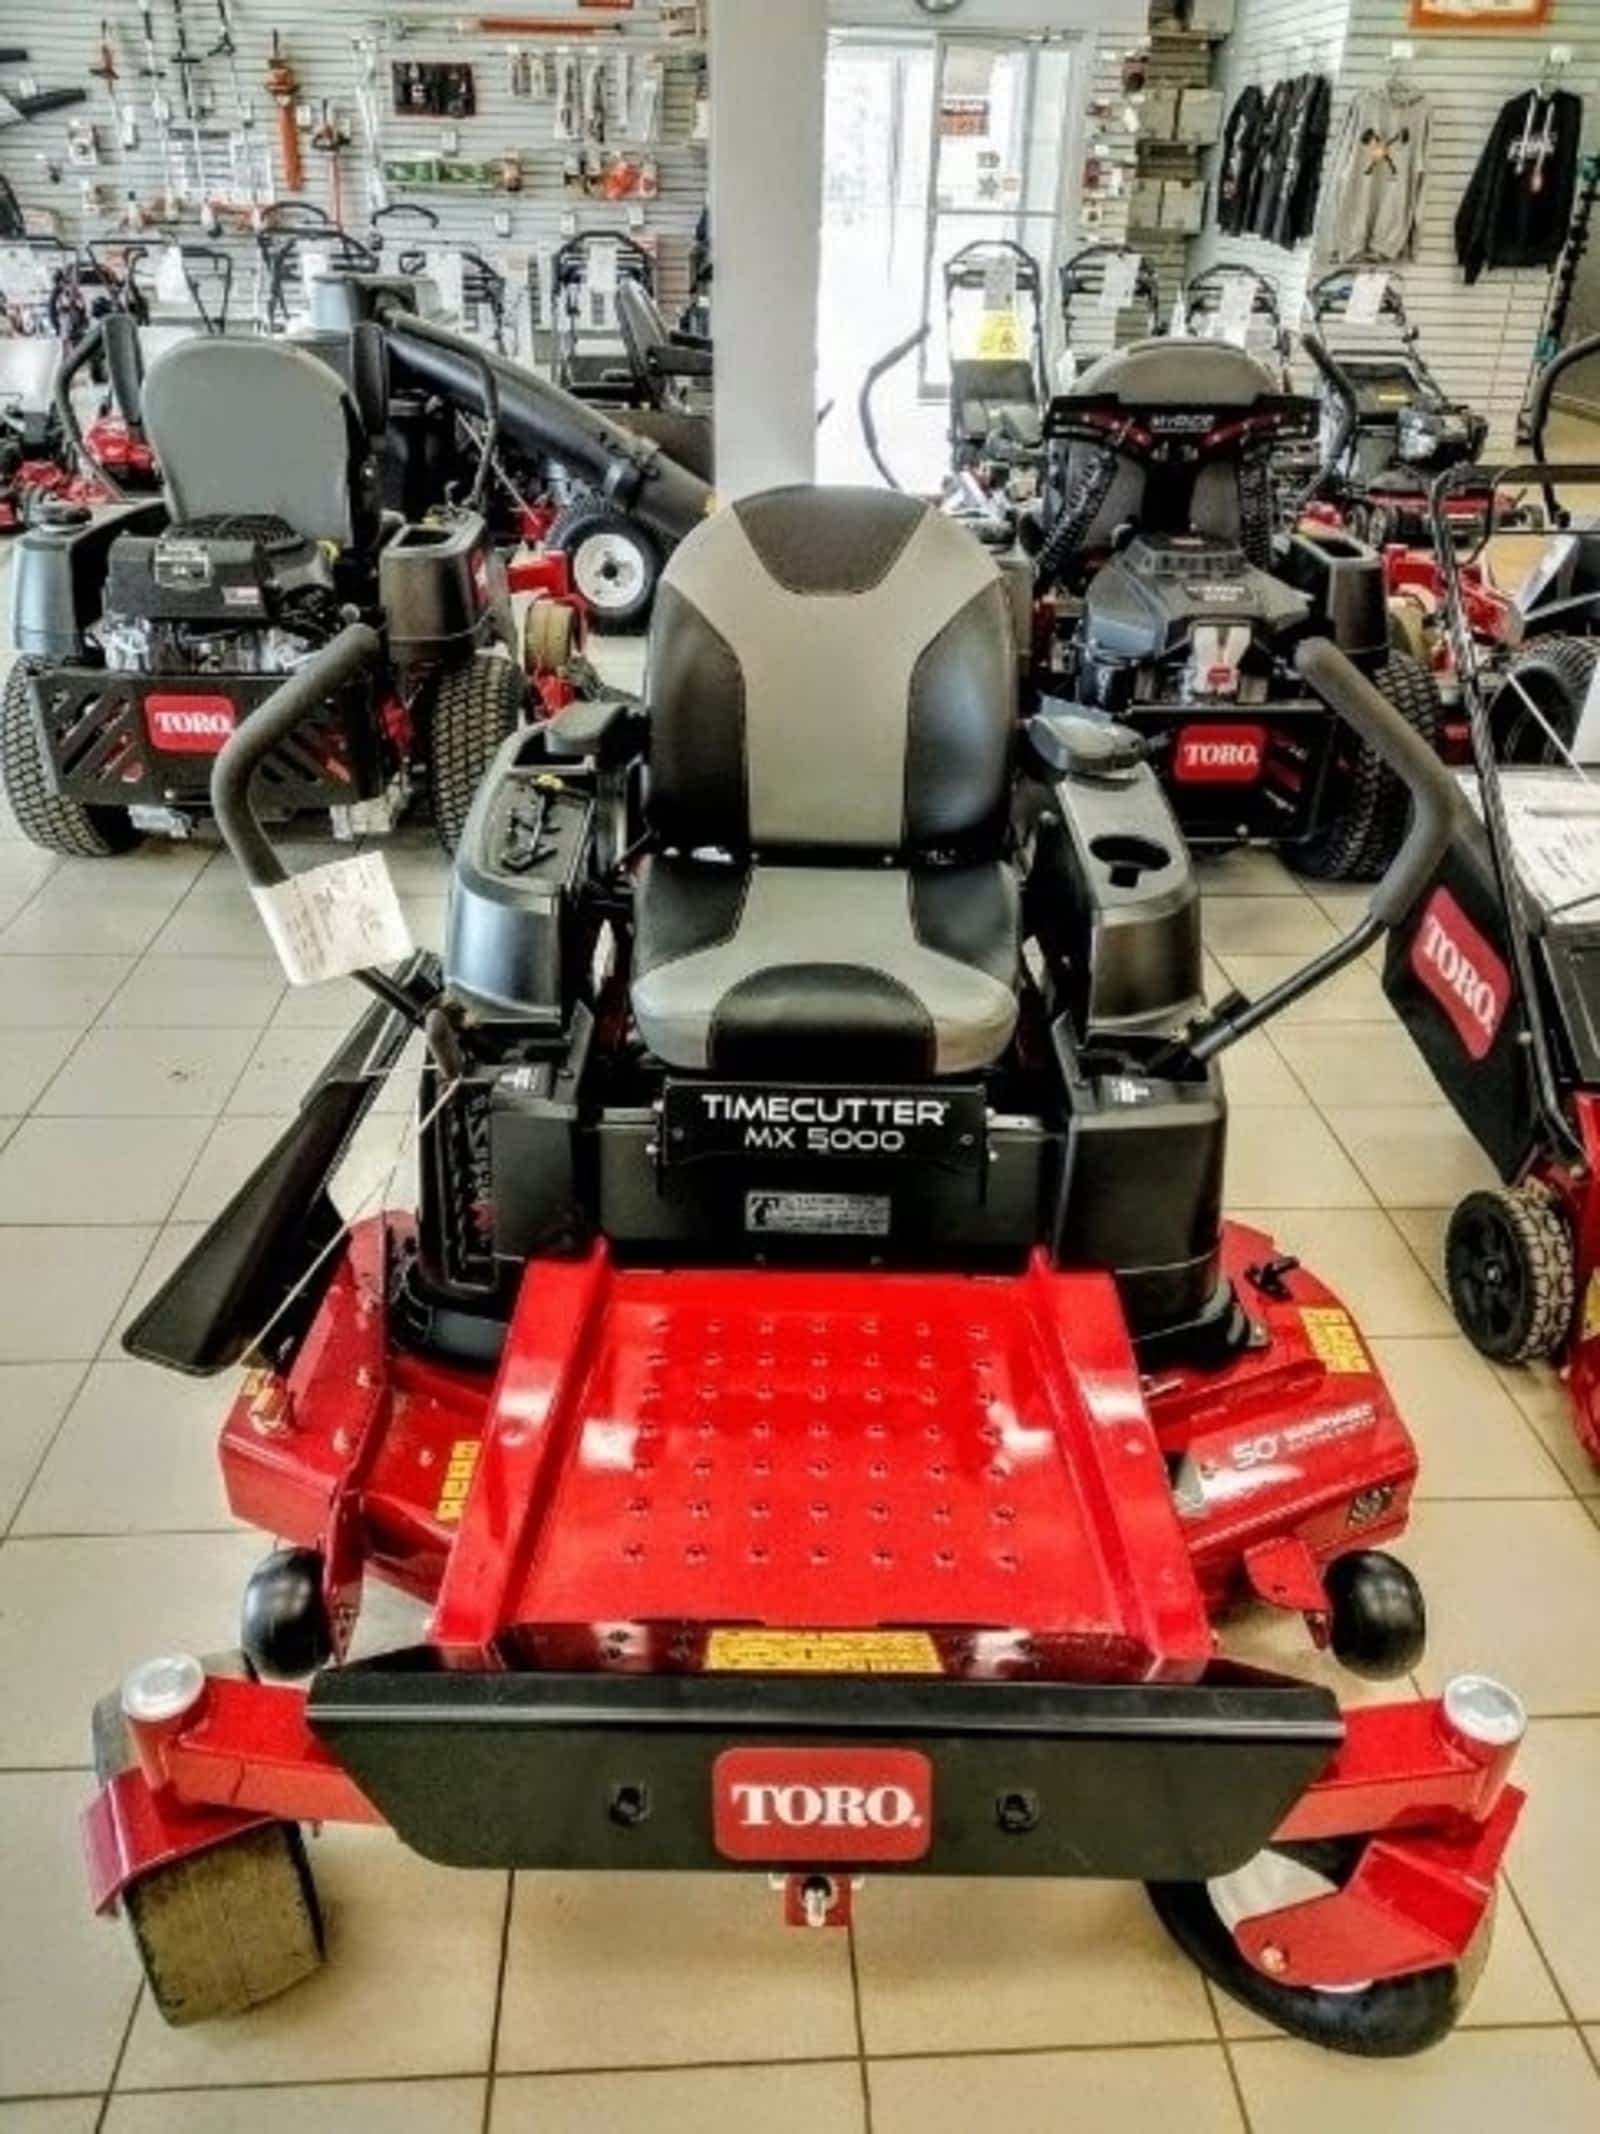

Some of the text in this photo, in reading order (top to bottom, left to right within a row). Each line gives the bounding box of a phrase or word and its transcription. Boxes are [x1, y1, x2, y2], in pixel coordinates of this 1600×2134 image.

[154, 711, 231, 734] TORO
[1183, 742, 1259, 766] TORO
[1424, 913, 1496, 1037] TORO
[701, 1093, 946, 1126] TIMECUTTER
[744, 1126, 905, 1152] MX 5000
[730, 1783, 923, 1829] TORO
